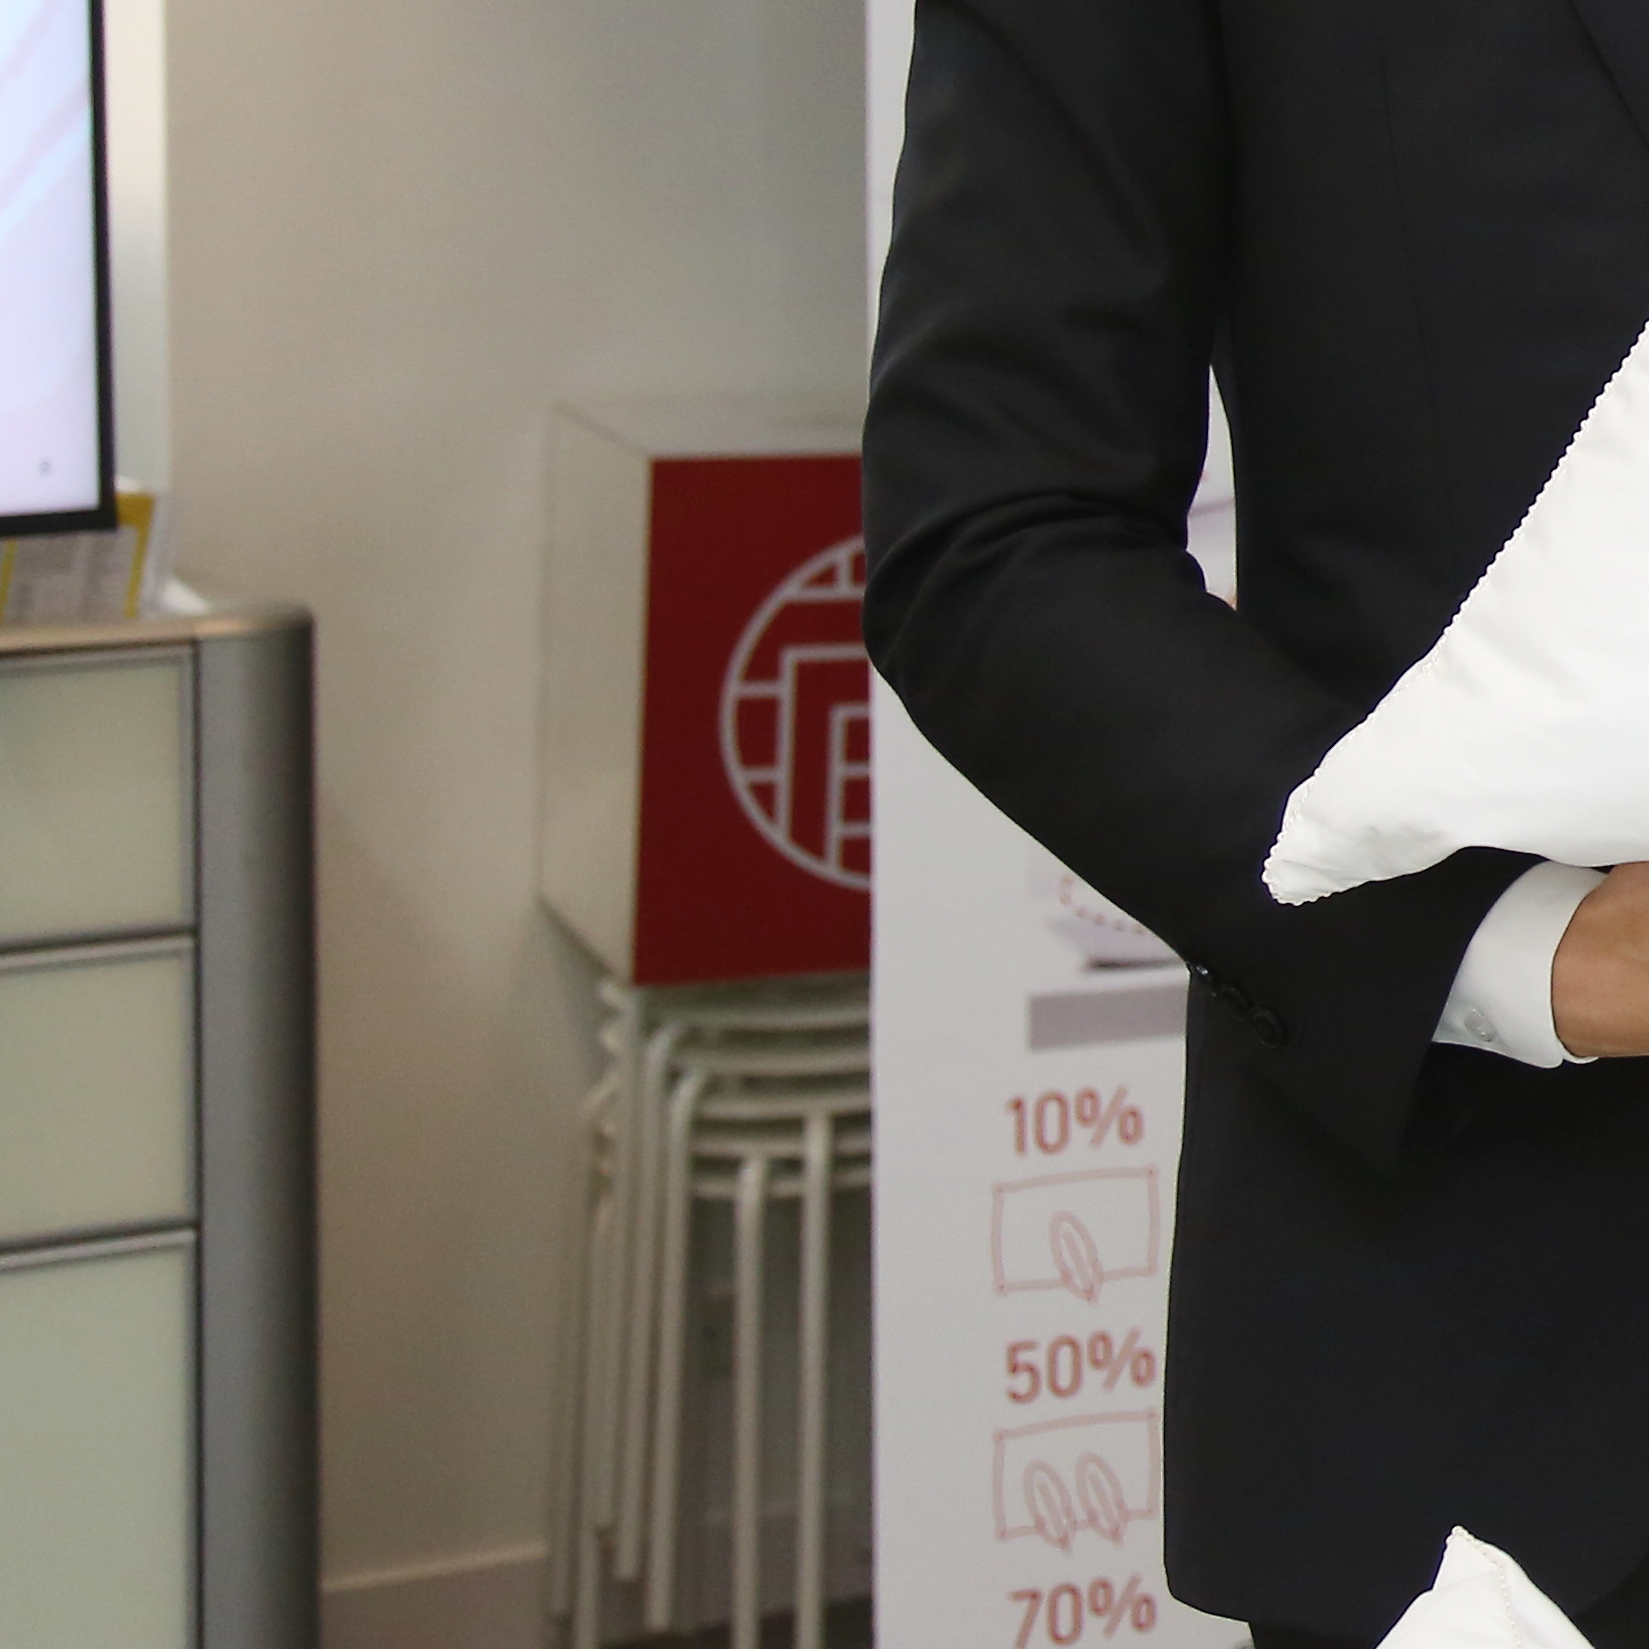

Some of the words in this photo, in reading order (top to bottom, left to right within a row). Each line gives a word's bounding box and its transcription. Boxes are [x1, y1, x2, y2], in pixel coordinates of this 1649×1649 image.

[1005, 1085, 1145, 1155] 10%
[1006, 1327, 1157, 1404] 50%
[1008, 1572, 1158, 1649] 70%
